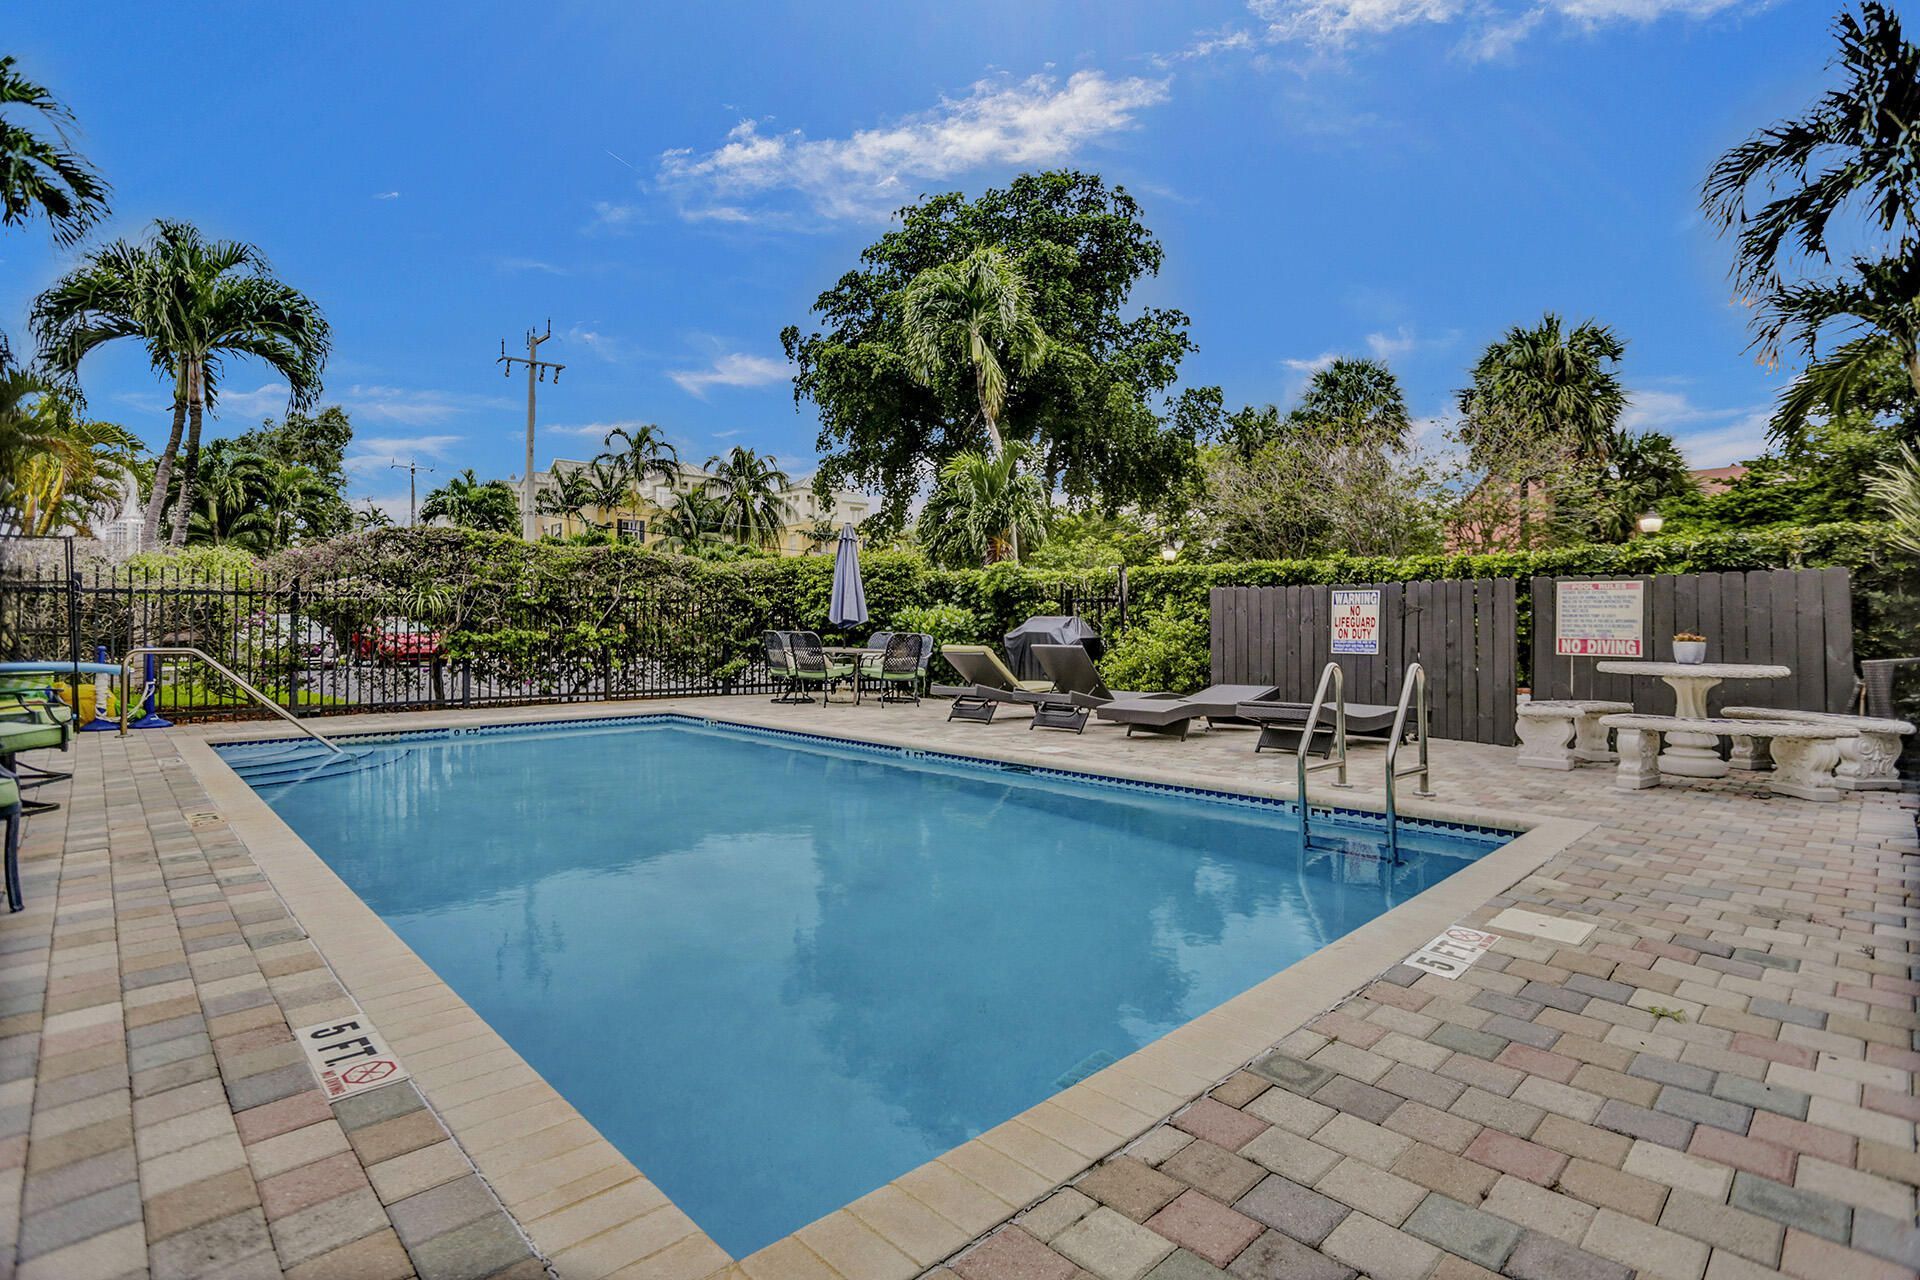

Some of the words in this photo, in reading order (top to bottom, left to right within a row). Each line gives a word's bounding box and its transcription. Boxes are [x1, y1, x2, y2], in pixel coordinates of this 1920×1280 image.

[1335, 592, 1377, 605] WARNING
[1349, 605, 1361, 616] NO
[1334, 617, 1376, 628] LIFEGUARD
[1338, 628, 1349, 639] ON
[1352, 628, 1372, 639] DUTY
[1561, 639, 1581, 653] NO
[1587, 639, 1637, 655] DIVING
[1415, 956, 1456, 971] 5
[310, 1021, 361, 1039] 5
